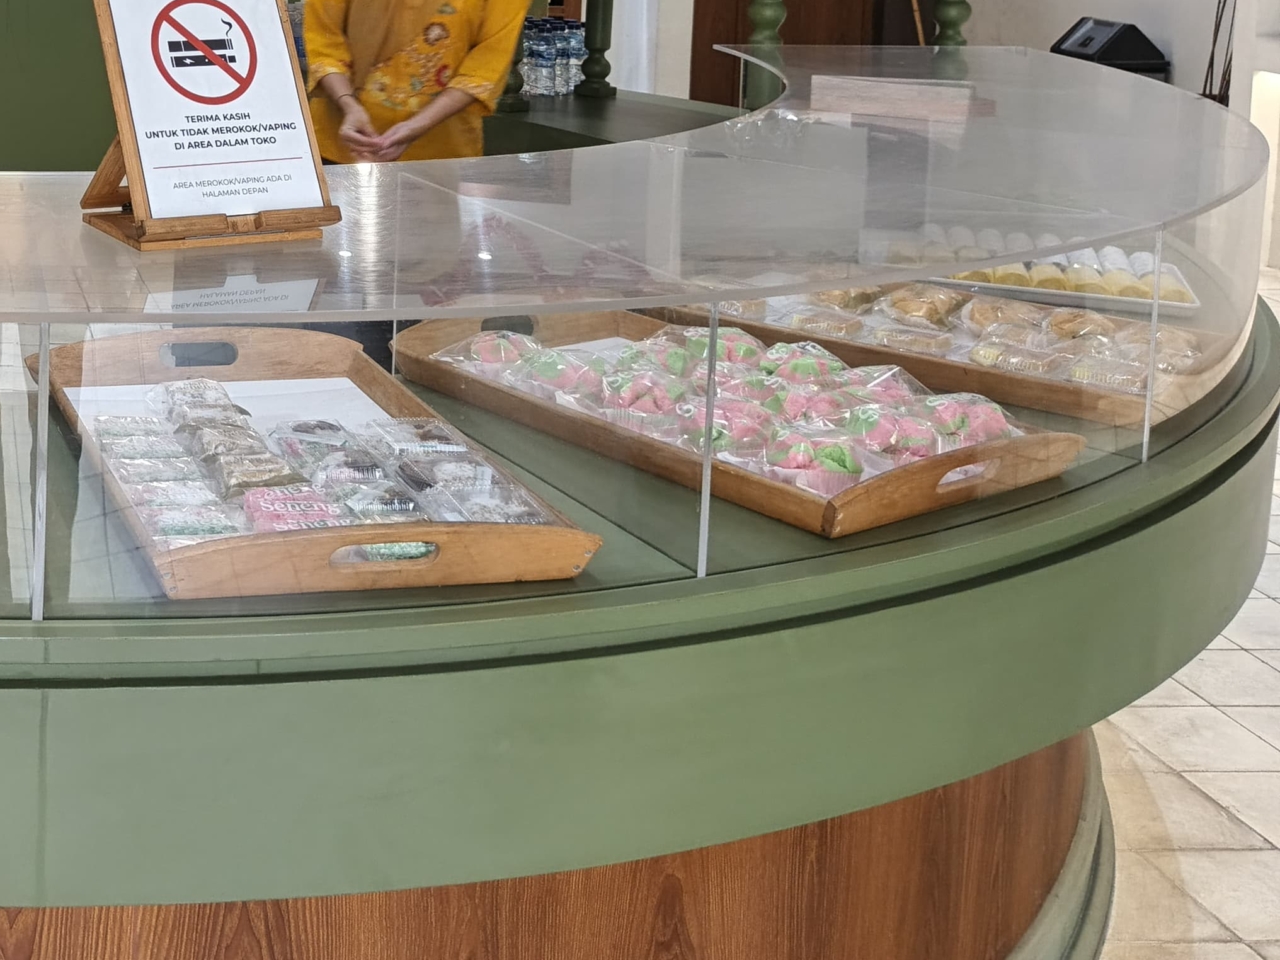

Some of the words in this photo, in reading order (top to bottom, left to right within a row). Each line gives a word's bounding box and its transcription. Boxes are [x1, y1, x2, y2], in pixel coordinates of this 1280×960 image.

[184, 113, 221, 124] TERIMA
[222, 112, 251, 121] KASIH
[145, 130, 179, 139] UNTUK
[180, 127, 209, 137] TIDAK
[211, 122, 297, 135] MEROKOK/VAPING
[174, 142, 185, 150] DI
[187, 140, 213, 150] AREA
[215, 138, 249, 148] DALAM
[250, 136, 277, 145] TOKO
[173, 181, 194, 190] AREA
[195, 176, 265, 188] MEROKOK/VAPING
[266, 174, 283, 183] ADA
[283, 174, 292, 182] DI
[202, 188, 241, 198] HALAMAN
[242, 187, 269, 195] DEPAN
[260, 501, 340, 515] Seneng
